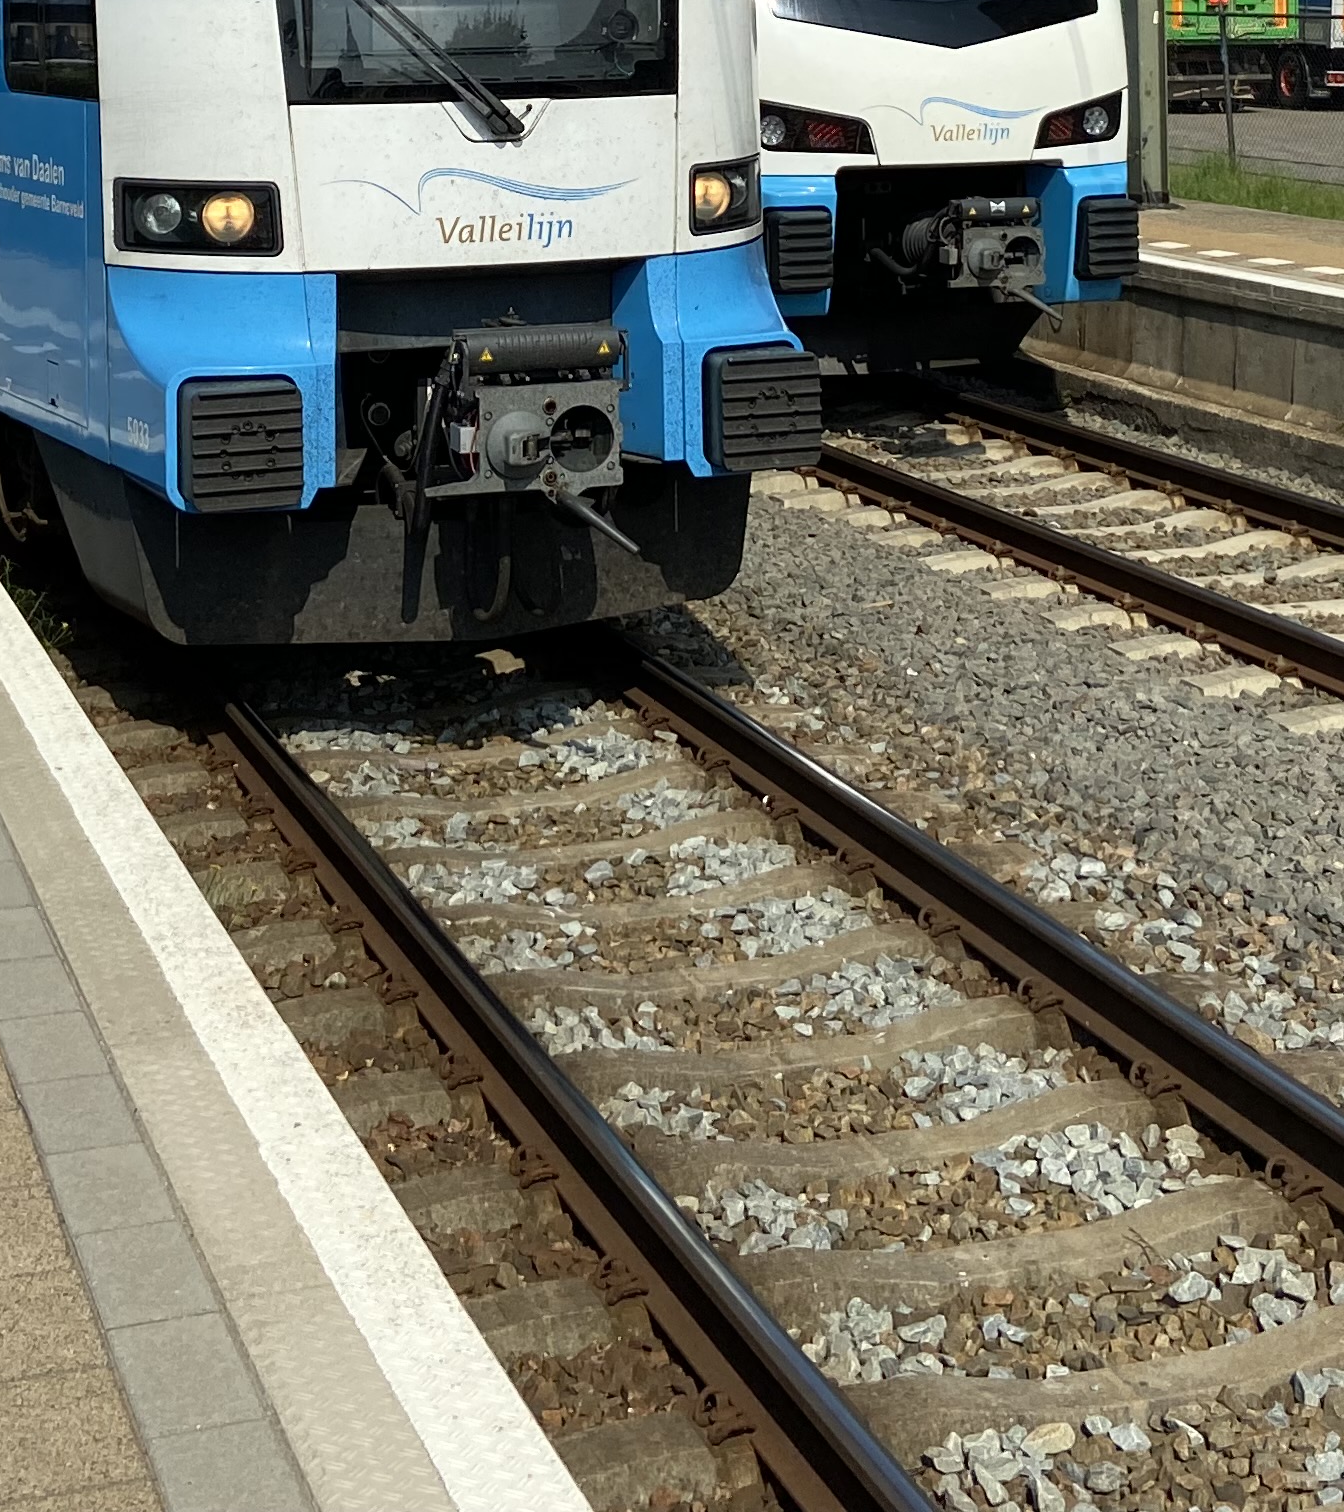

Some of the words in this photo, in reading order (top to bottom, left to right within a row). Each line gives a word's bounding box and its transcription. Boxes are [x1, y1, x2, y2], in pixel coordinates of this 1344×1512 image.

[930, 122, 1010, 146] Valleilijn
[13, 156, 30, 178] van
[32, 154, 64, 186] Daalen
[51, 195, 84, 219] Barneveld
[435, 211, 573, 248] Valleilijn
